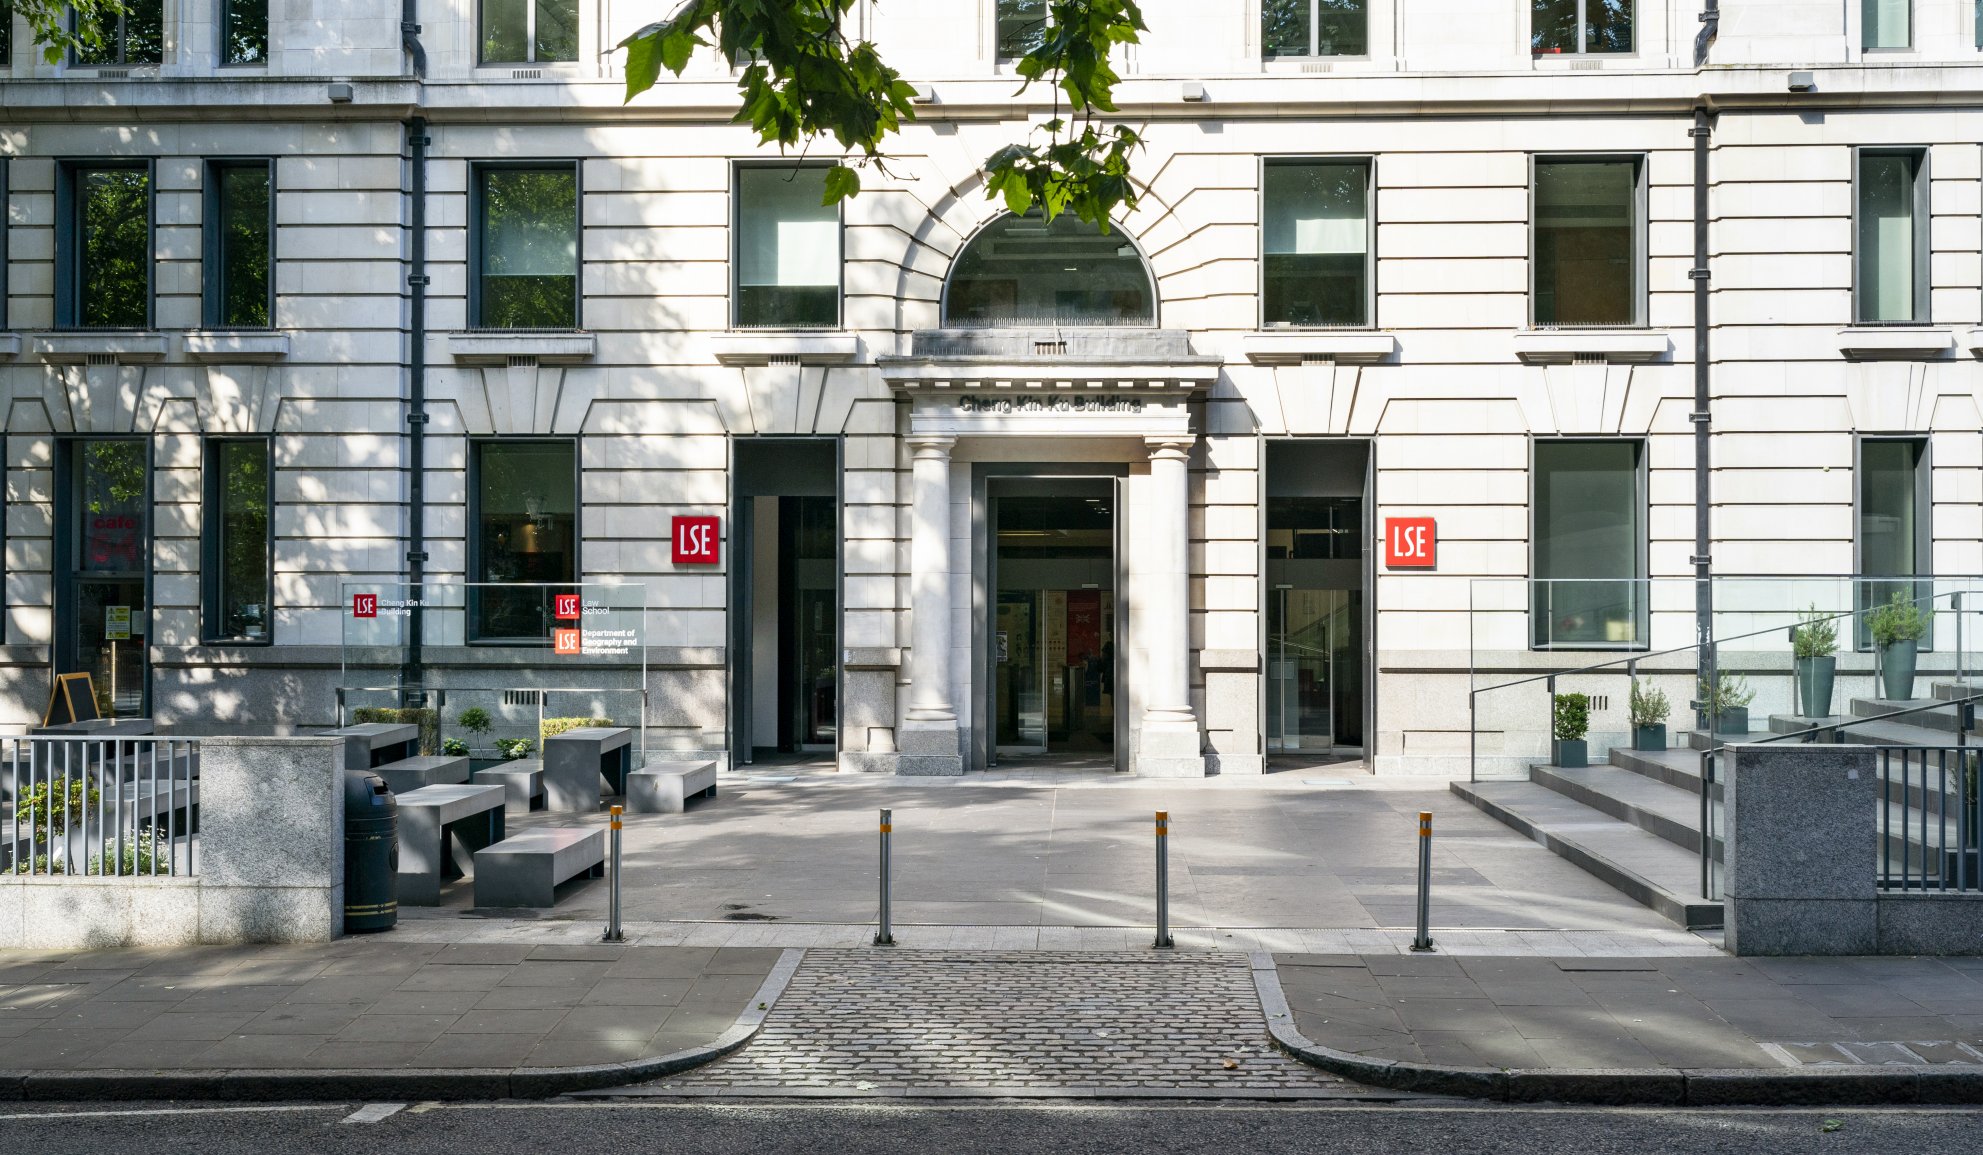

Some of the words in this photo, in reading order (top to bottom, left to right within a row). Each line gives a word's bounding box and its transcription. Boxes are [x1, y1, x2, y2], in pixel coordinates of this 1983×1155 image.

[959, 395, 1012, 414] Cheng
[1016, 395, 1043, 412] Kin
[1047, 395, 1069, 411] Ku
[1073, 395, 1143, 414] Building
[680, 524, 711, 555] LSE
[1394, 526, 1426, 557] LSE
[357, 598, 373, 613] LSE
[381, 600, 405, 608] Cheng
[406, 599, 419, 607] Kin
[559, 599, 576, 615] LSE
[582, 599, 599, 607] Law
[381, 608, 411, 616] Building
[582, 606, 610, 615] School
[582, 629, 626, 638] Department
[627, 629, 635, 637] of
[559, 633, 576, 650] LSE
[582, 638, 621, 647] Geography
[623, 638, 637, 646] and
[582, 647, 628, 655] Environment
